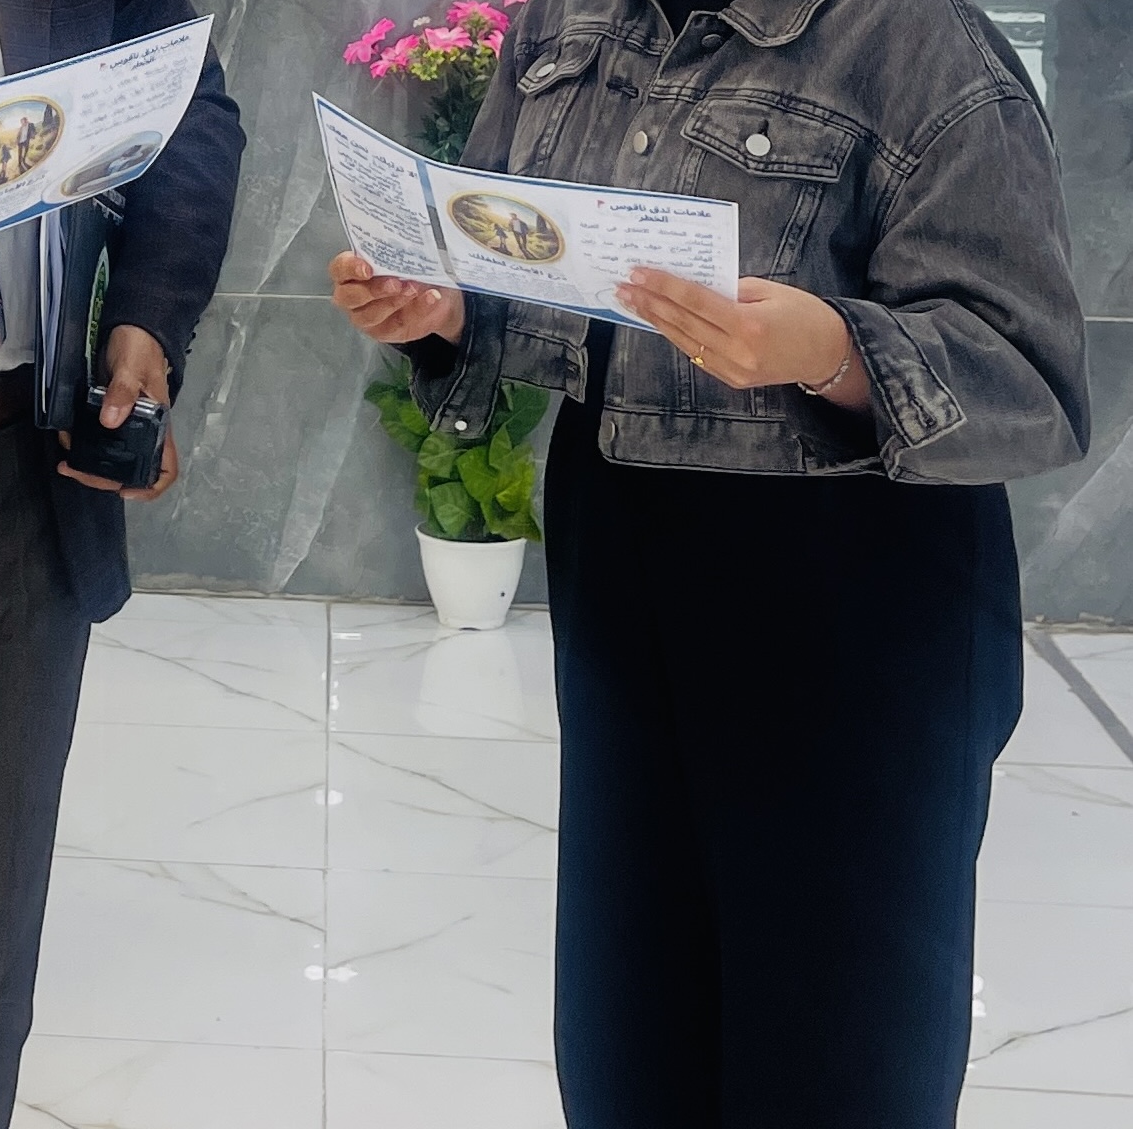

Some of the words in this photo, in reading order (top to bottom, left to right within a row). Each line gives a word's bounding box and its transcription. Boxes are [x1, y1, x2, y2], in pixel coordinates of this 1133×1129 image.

[610, 204, 647, 212] ناقوس
[674, 209, 711, 218] علامات
[639, 215, 669, 223] الخطر
